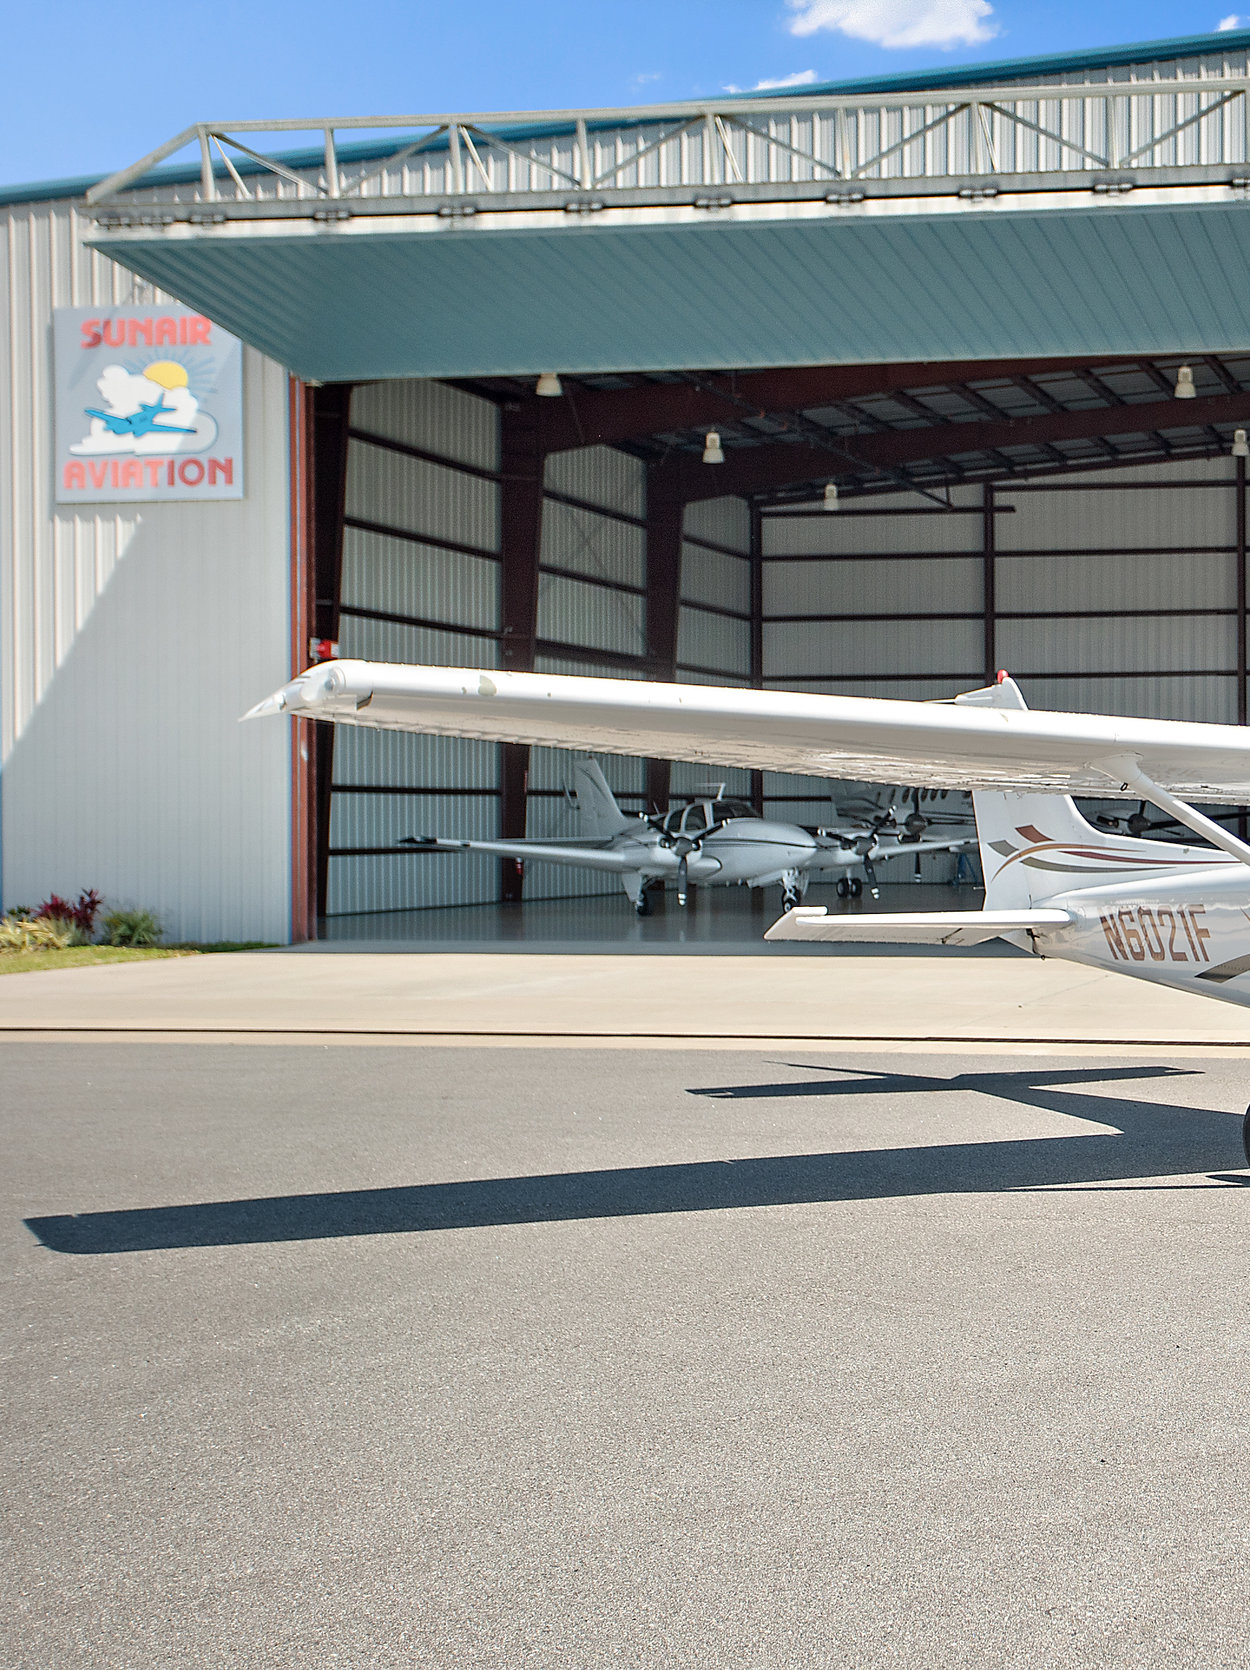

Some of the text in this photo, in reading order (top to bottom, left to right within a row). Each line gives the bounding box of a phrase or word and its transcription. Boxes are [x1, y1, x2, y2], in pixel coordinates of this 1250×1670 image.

[80, 315, 212, 349] SUNAIR
[63, 457, 234, 490] AVIATION
[1098, 904, 1211, 962] N6021F
